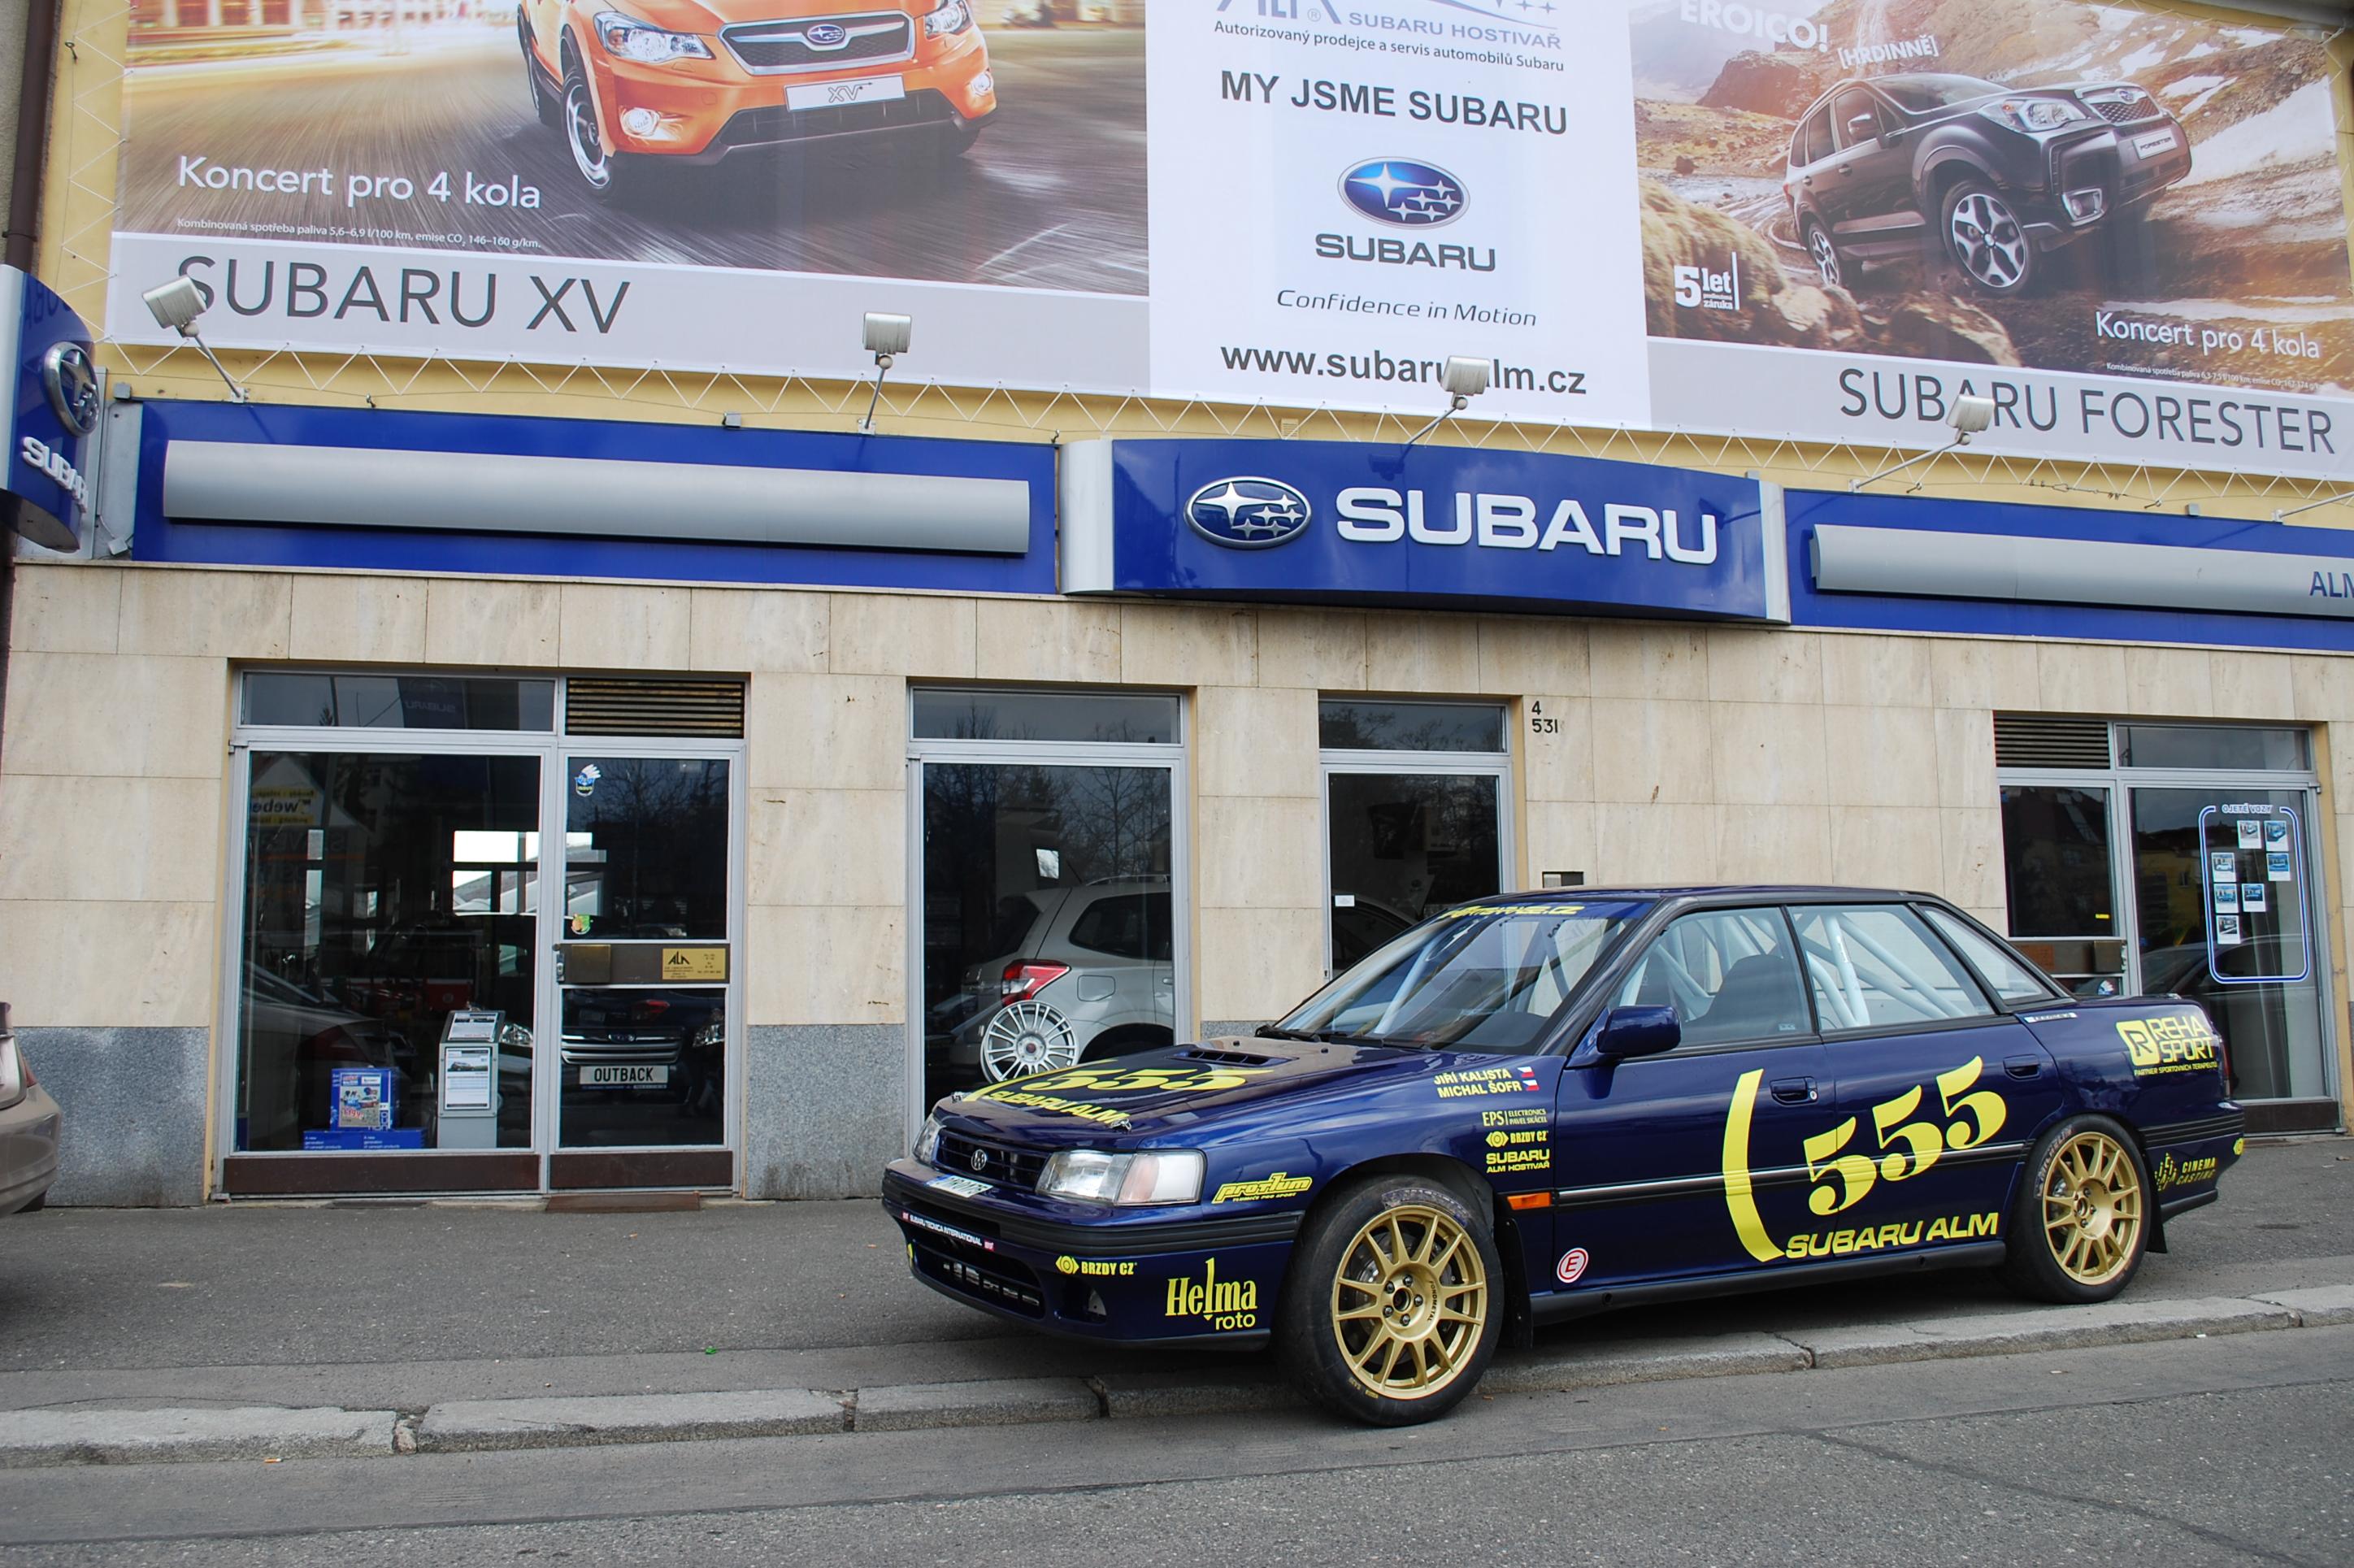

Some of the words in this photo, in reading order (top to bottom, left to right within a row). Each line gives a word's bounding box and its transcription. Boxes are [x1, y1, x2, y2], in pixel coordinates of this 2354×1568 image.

[1349, 12, 1444, 36] SUBARU
[1452, 24, 1561, 50] HOSTIVAŘ
[1214, 20, 1309, 45] Autorizovaný
[1314, 33, 1375, 51] prodejce
[1379, 41, 1387, 51] a
[1391, 42, 1430, 56] servis
[1434, 47, 1513, 66] automobilů
[1517, 55, 1564, 72] Subaru
[827, 83, 863, 102] XV
[1222, 70, 1279, 104] MY
[1291, 79, 1396, 118] JSME
[1409, 90, 1568, 135] SUBARU
[180, 155, 333, 195] Koncert
[348, 175, 414, 207] pro
[428, 172, 451, 202] 4
[465, 171, 541, 208] kola
[177, 217, 247, 231] Kombinovaná
[250, 223, 295, 235] spotřeba
[298, 225, 327, 237] paliva
[395, 231, 414, 241] km,
[415, 232, 445, 242] emise
[512, 238, 541, 249] g/km.
[1314, 233, 1496, 271] SUBARU
[178, 255, 496, 328] SUBARU
[527, 275, 630, 334] XV
[1674, 265, 1702, 307] 5
[1701, 267, 1732, 293] let
[1276, 289, 1421, 319] Confidence
[1428, 298, 1448, 319] in
[1454, 303, 1537, 327] Motion
[2096, 311, 2195, 346] Koncert
[2201, 328, 2243, 356] pro
[2251, 328, 2265, 353] 4
[2273, 329, 2320, 358] kola
[1221, 346, 1587, 395] www.subarlm.cz
[2106, 363, 2152, 374] Kombinovaná
[2081, 389, 2335, 454] FORESTER
[1335, 487, 1718, 566] SUBARU
[1531, 700, 1542, 715] 4
[1531, 718, 1558, 733] 531
[2222, 802, 2249, 814] OJETÉ
[2146, 1015, 2209, 1041] REHA
[2159, 1036, 2213, 1063] SPORT
[593, 1066, 654, 1083] OUTBACK
[1021, 1068, 1275, 1090] 555
[1434, 1071, 1458, 1085] JIŘÍ
[1461, 1068, 1512, 1082] KALISTA
[1437, 1083, 1488, 1098] MICHAL
[1488, 1076, 1522, 1094] ŠOFR
[1482, 1110, 1505, 1127] EPS
[1510, 1131, 1535, 1144] BRZDY
[1536, 1130, 1547, 1142] CZ
[1803, 1056, 2007, 1216] 555
[1486, 1149, 1550, 1164] SUBARU
[1487, 1165, 1506, 1173] ALM
[1508, 1161, 1550, 1171] HOSTIVAŘ
[2182, 1157, 2216, 1173] CINEMA
[1785, 1220, 1924, 1260] SUBARU
[1926, 1212, 1999, 1241] ALM
[1081, 1261, 1117, 1275] BRZDY
[1119, 1262, 1134, 1275] CZ
[1564, 1254, 1579, 1273] E
[1165, 1257, 1258, 1316] Helma
[1215, 1312, 1256, 1331] roto
